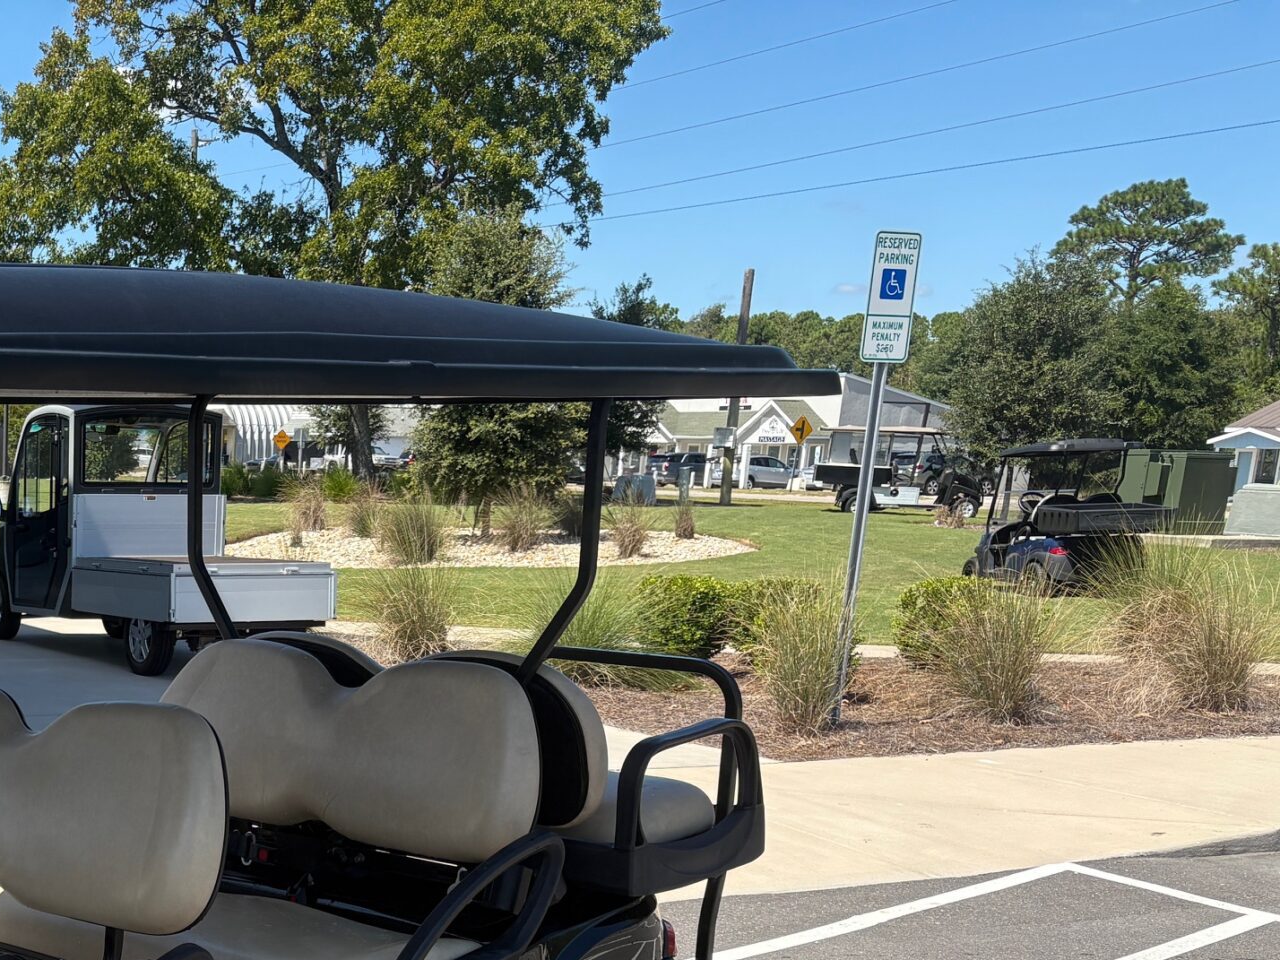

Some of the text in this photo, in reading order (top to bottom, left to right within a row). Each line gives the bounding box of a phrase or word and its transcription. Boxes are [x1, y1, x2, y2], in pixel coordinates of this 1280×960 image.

[877, 237, 918, 249] RESERVED
[878, 252, 914, 265] PARKING
[872, 321, 903, 330] MAXIMUM
[871, 332, 900, 342] PENALTY
